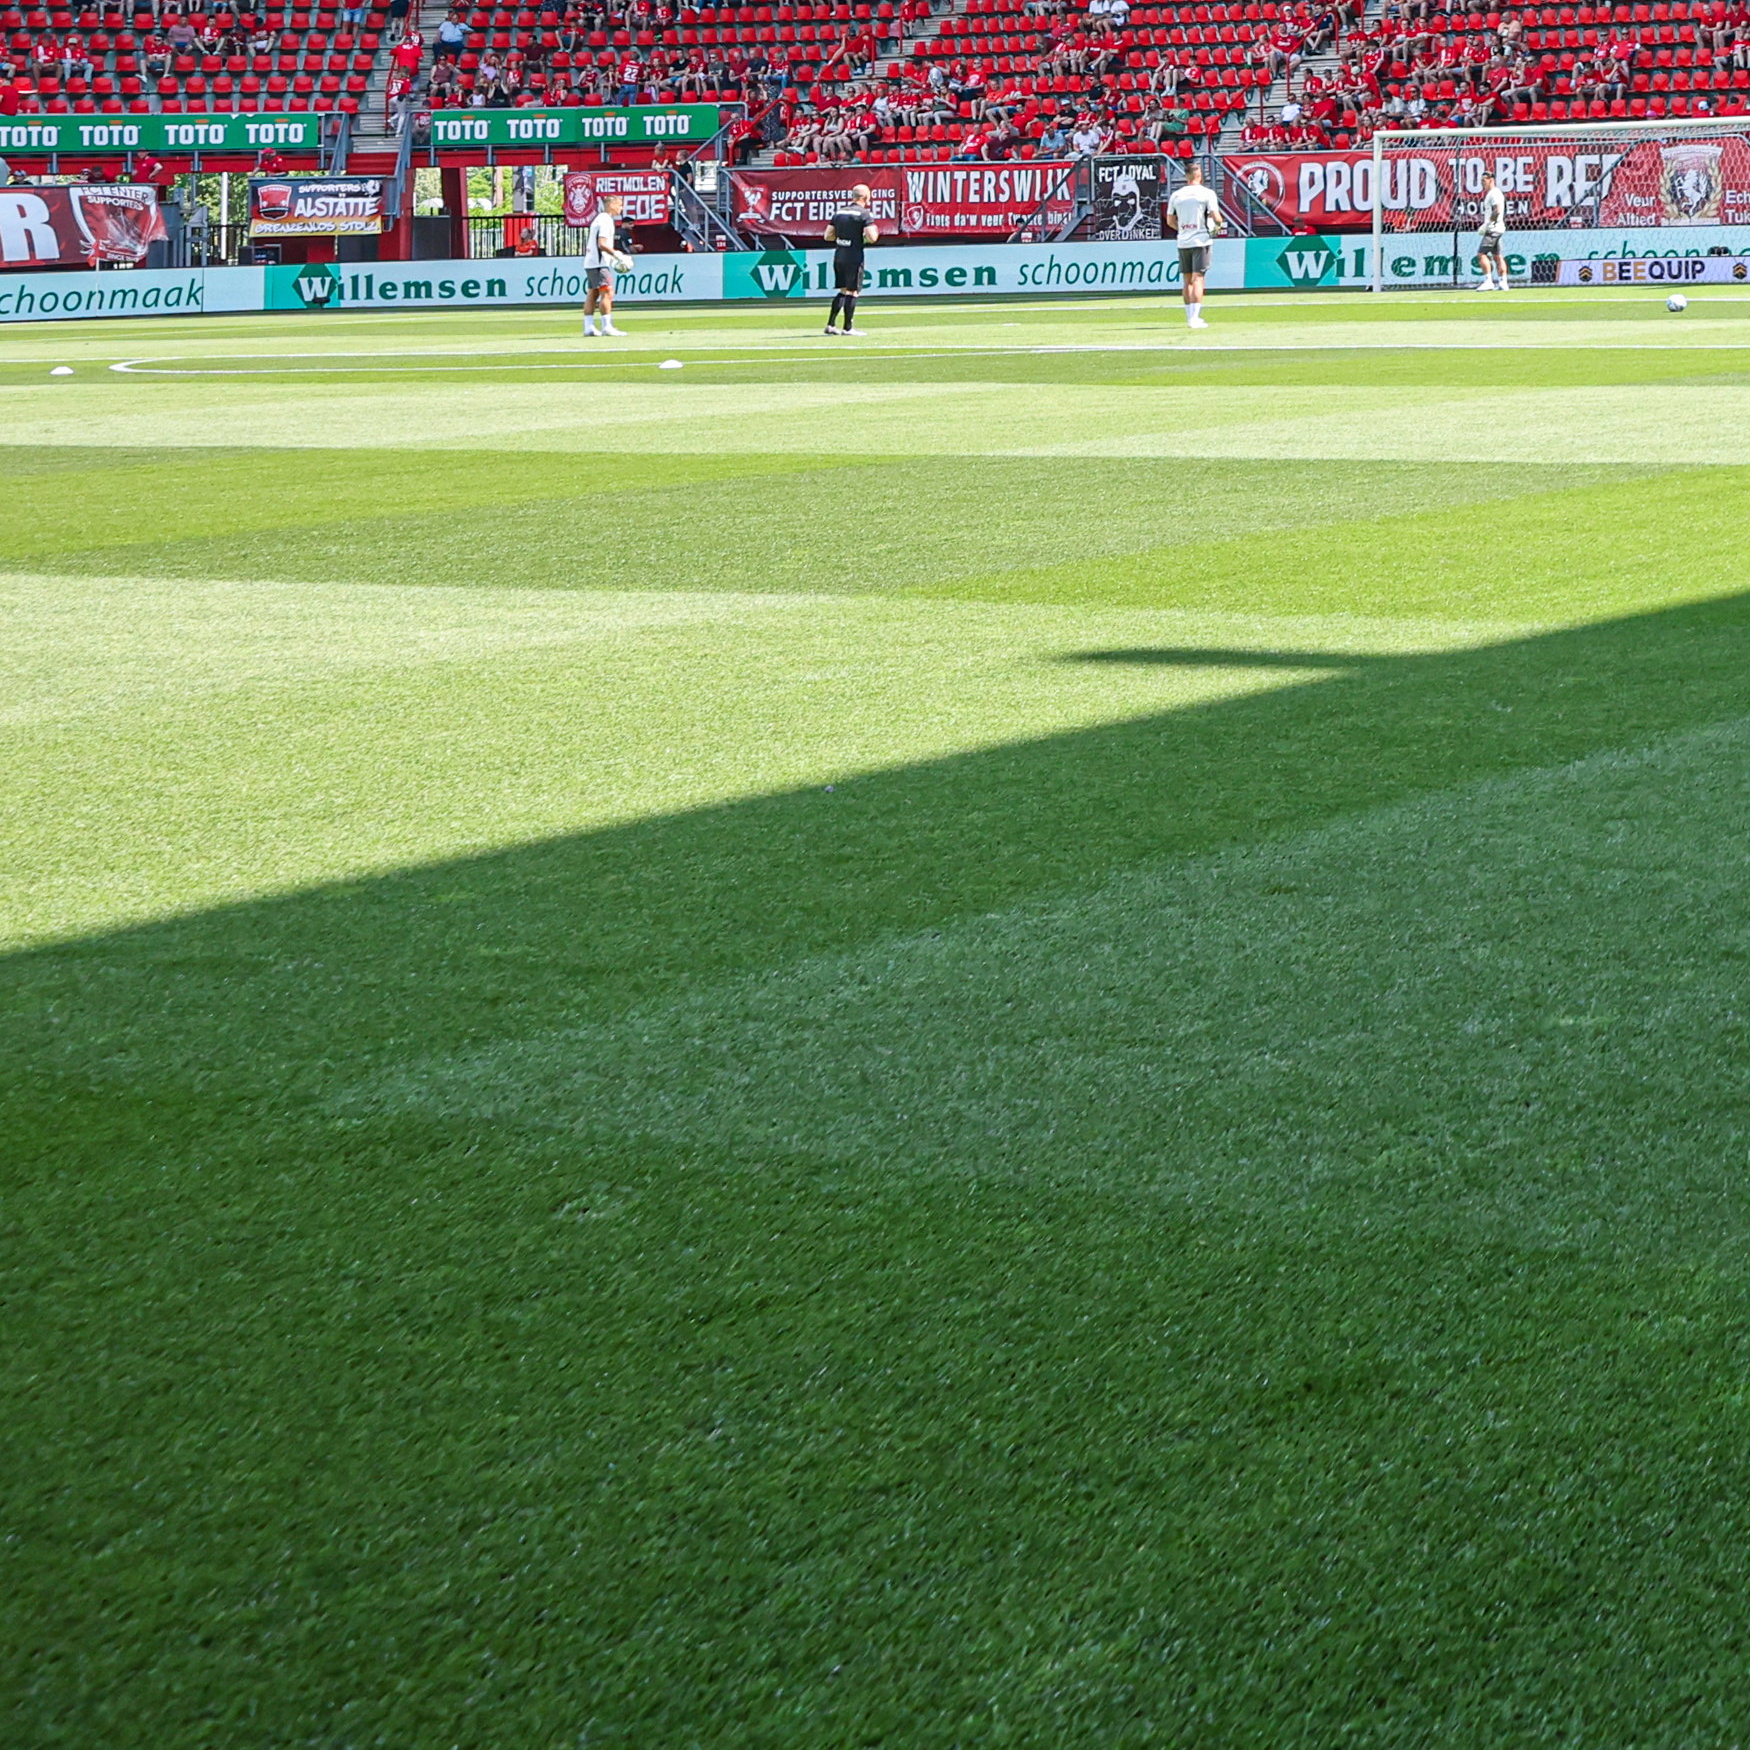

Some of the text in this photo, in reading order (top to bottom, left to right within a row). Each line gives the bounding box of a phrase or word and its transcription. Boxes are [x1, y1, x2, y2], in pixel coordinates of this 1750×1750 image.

[80, 125, 140, 147] TOTO
[164, 124, 226, 146] TOTO
[246, 123, 306, 145] TOTO
[434, 115, 691, 141] TOTO TOTO TOTO TOTO
[596, 176, 666, 193] RIETMOLEN
[906, 168, 1074, 203] WINTERSWIJK
[1099, 164, 1157, 183] FCT LOYAL
[1298, 159, 1438, 213] PROUD
[1495, 156, 1535, 193] BE
[298, 182, 362, 195] SUPPORTERS
[293, 192, 380, 217] ALSTÄTTE
[769, 202, 806, 222] FCT
[1602, 260, 1706, 283] BEEQUIP
[297, 271, 507, 302] Willemsen
